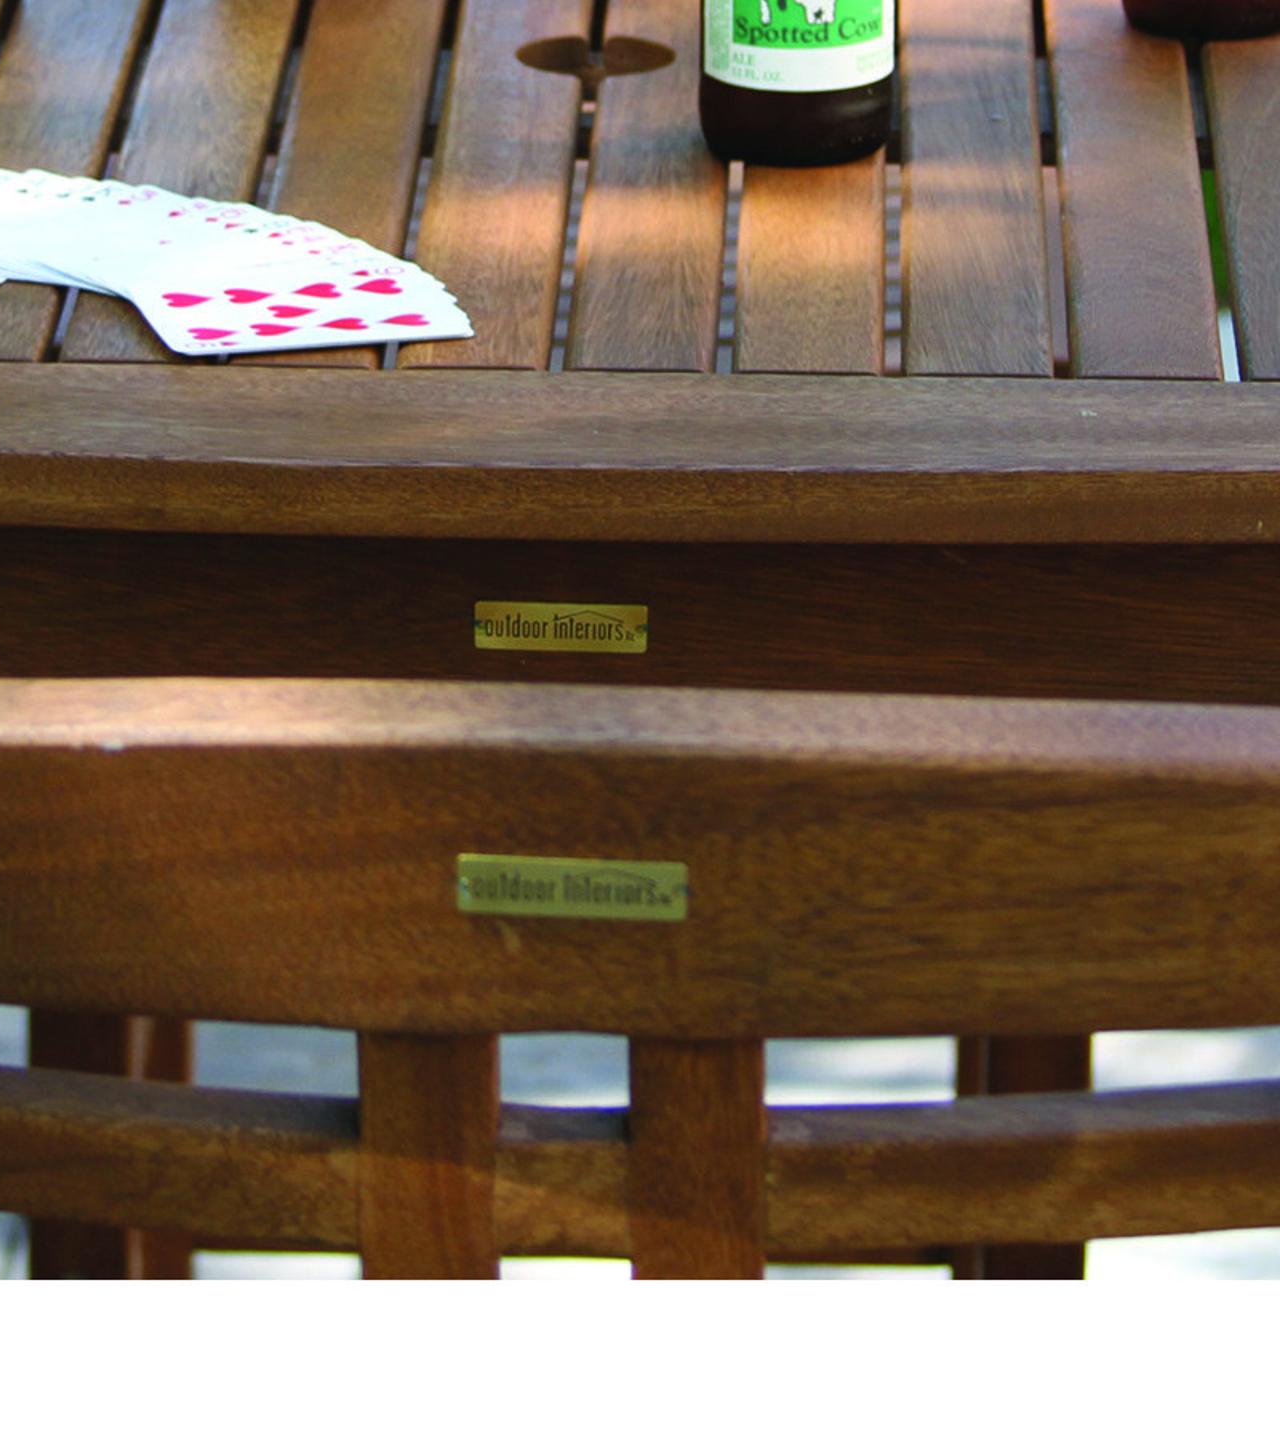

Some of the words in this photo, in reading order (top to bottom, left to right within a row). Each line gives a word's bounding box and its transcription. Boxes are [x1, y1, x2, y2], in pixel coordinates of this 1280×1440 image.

[735, 16, 830, 46] Spotted
[837, 16, 880, 40] Cow
[484, 612, 549, 639] outdoor
[553, 613, 624, 641] interiors
